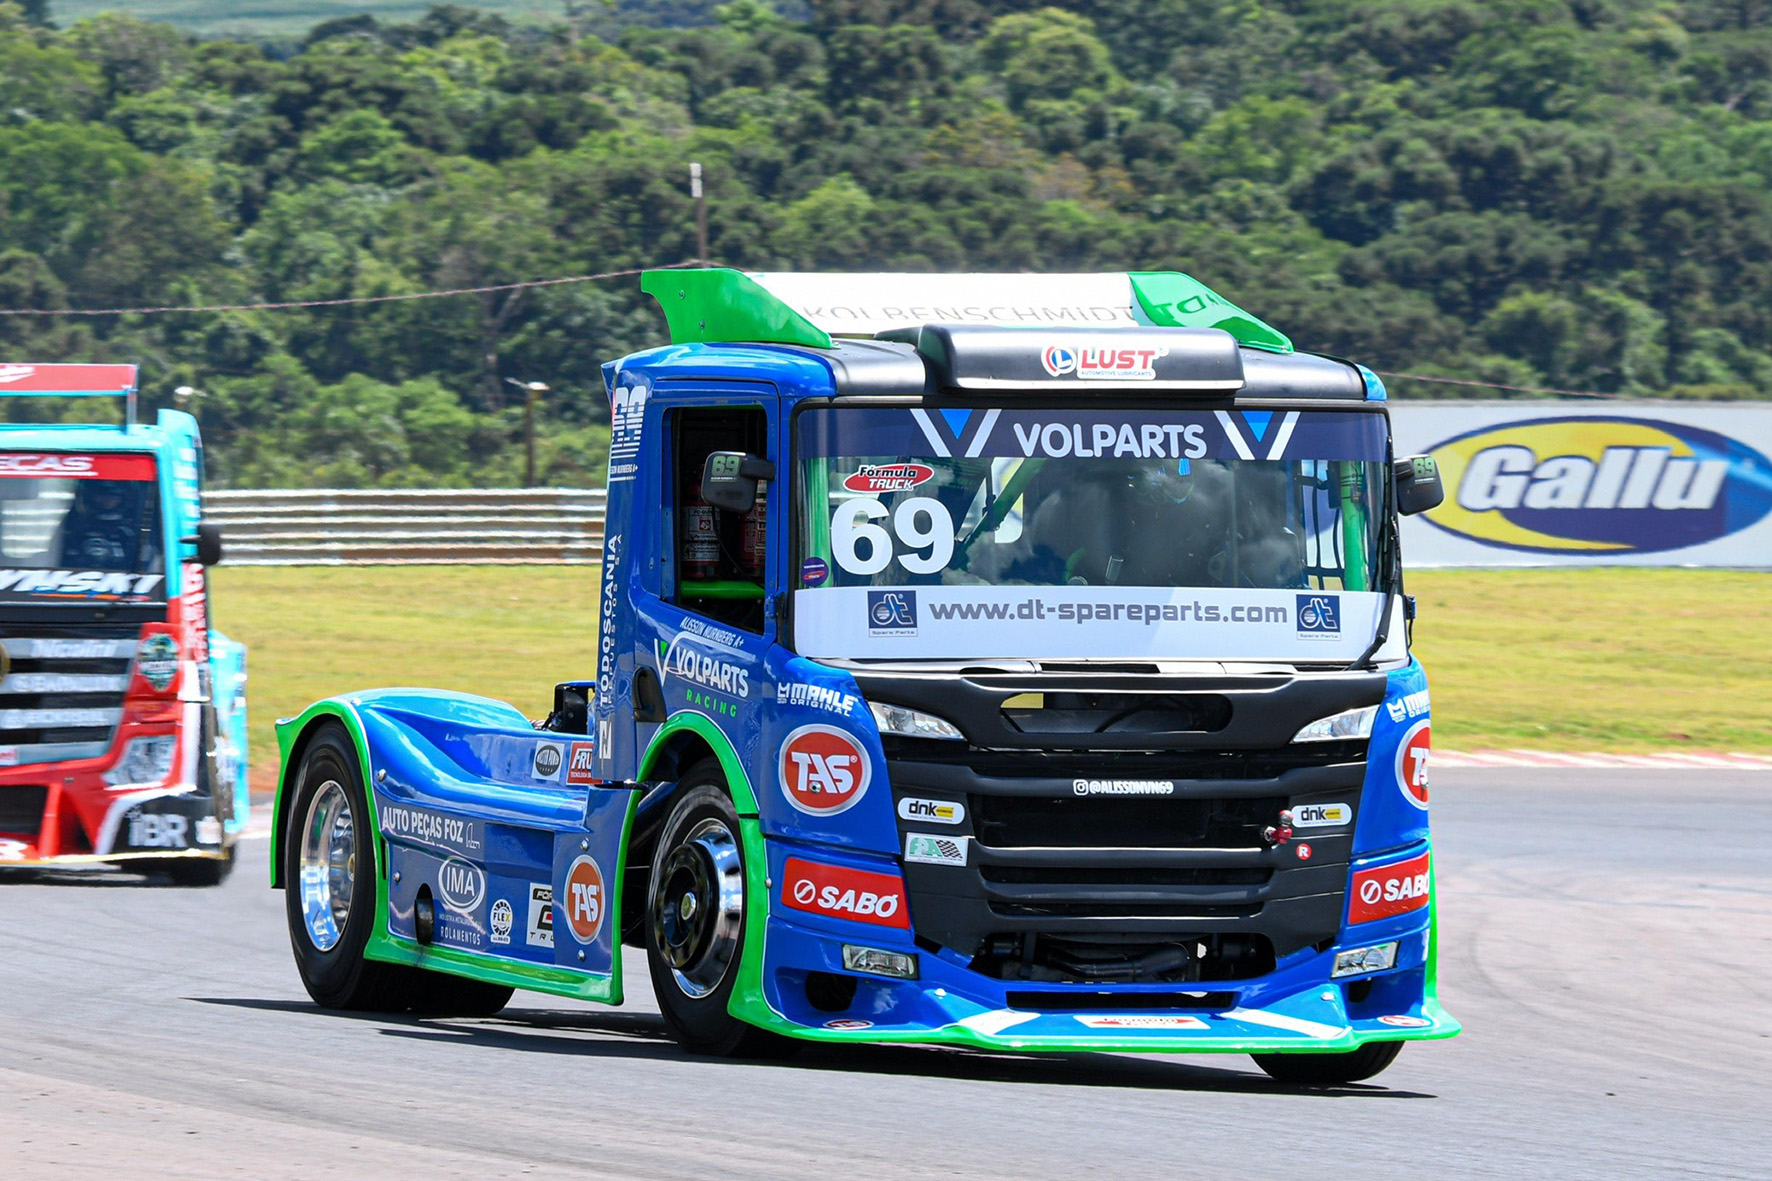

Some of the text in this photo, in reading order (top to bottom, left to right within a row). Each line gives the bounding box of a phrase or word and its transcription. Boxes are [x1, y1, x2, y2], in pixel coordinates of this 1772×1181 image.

[1081, 349, 1155, 369] LUST
[1013, 423, 1208, 460] VOLPARTS
[712, 456, 740, 476] 69
[859, 466, 917, 479] Fórmula
[1457, 444, 1730, 513] Gallu
[869, 478, 914, 491] TRUCK
[831, 497, 955, 576] 69
[600, 534, 618, 707] TODOSCANIA
[680, 615, 707, 635] ALISSON
[929, 599, 1287, 625] www.dt-spareparts.com
[676, 646, 749, 698] VOLPARTS
[686, 688, 738, 717] RACING
[789, 697, 851, 717] ORIGINAL
[790, 683, 859, 712] MAHLE
[791, 751, 855, 794] TAS
[909, 801, 937, 816] dnk
[1301, 806, 1326, 821] dnk
[382, 806, 464, 843] AUTO PEÇAS FOZ
[1298, 846, 1309, 857] R
[446, 866, 475, 897] IMA
[572, 883, 599, 922] TAS
[493, 912, 511, 922] FLEX
[440, 926, 481, 945] ROLAMENTOS
